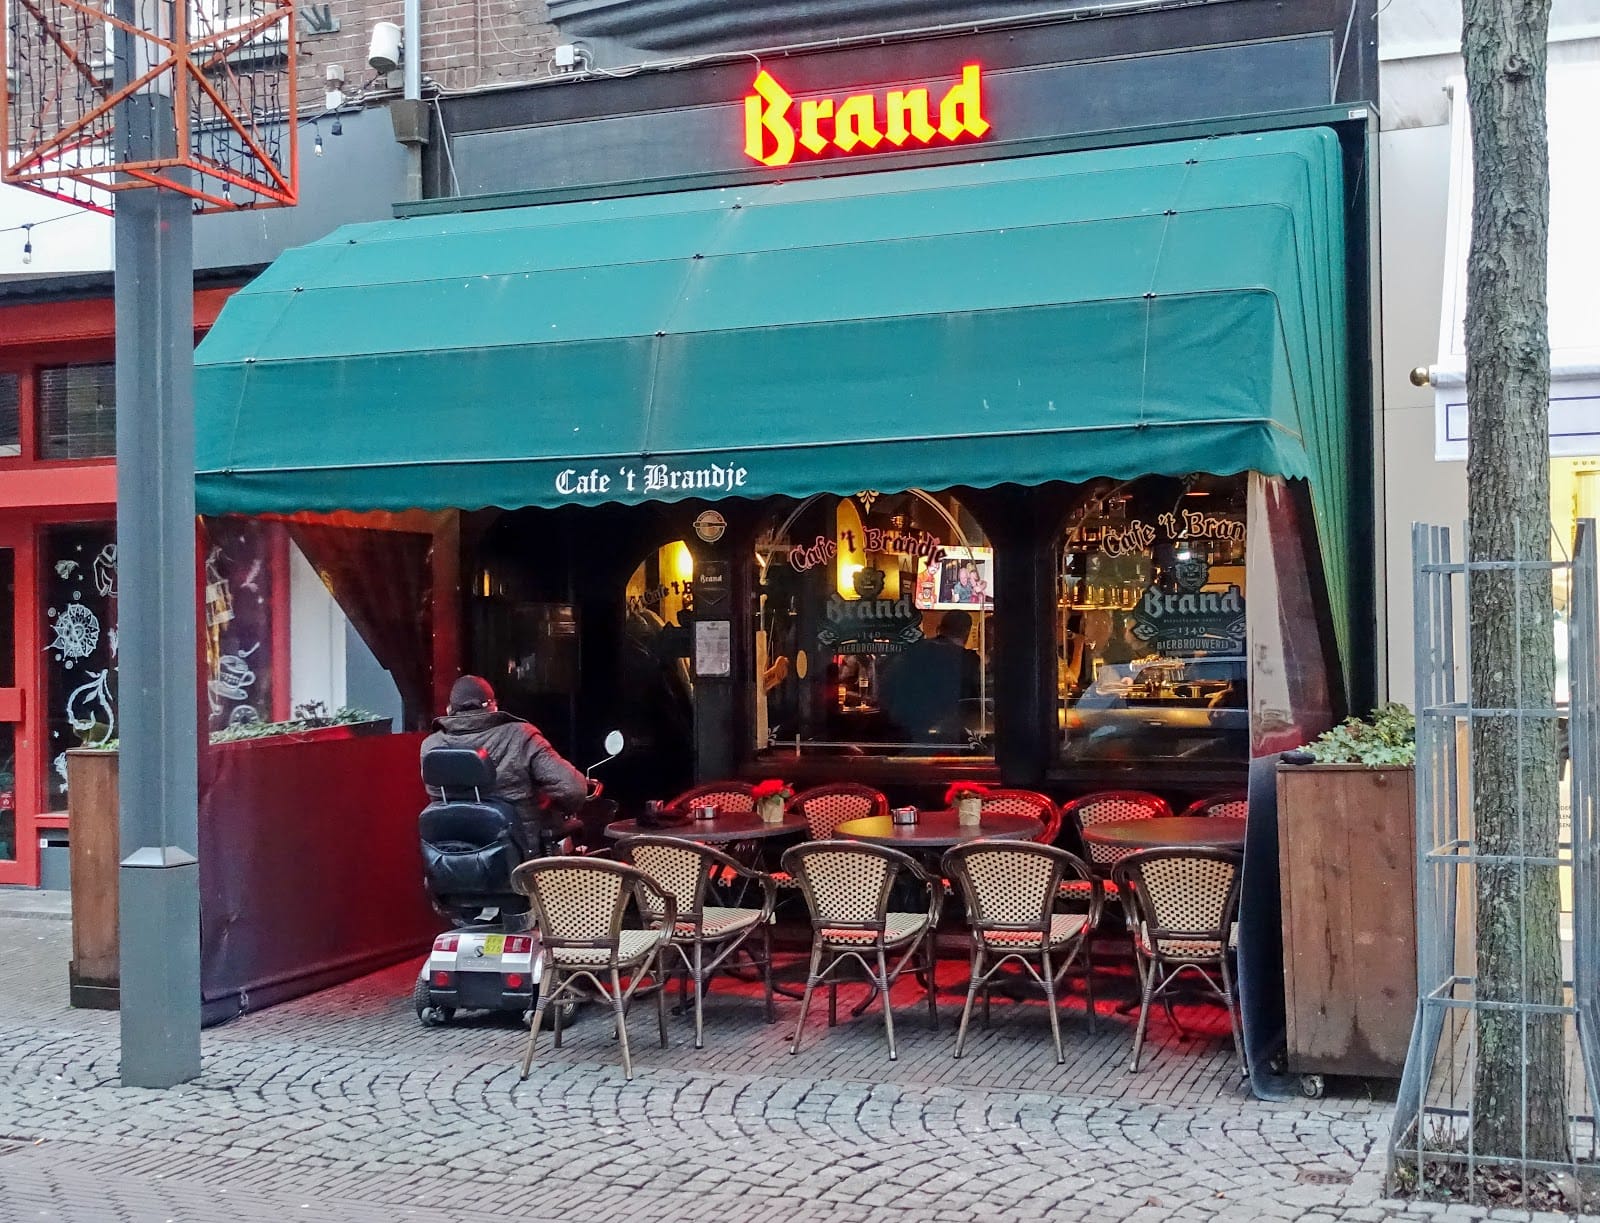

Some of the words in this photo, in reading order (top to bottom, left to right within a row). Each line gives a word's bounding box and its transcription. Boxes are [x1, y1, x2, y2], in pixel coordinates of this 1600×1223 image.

[744, 64, 991, 167] Brand
[555, 469, 611, 494] Cafe
[644, 461, 748, 494] Brandje
[789, 535, 837, 573] Cafe
[861, 525, 947, 568] Brandje
[1102, 520, 1156, 558] Cafe
[1182, 509, 1246, 541] Bran
[700, 574, 723, 584] Brand
[826, 593, 912, 624] Brand
[1144, 585, 1241, 618] Brand
[1156, 638, 1229, 650] BIERBROUWERIJ
[1178, 626, 1206, 636] 1340
